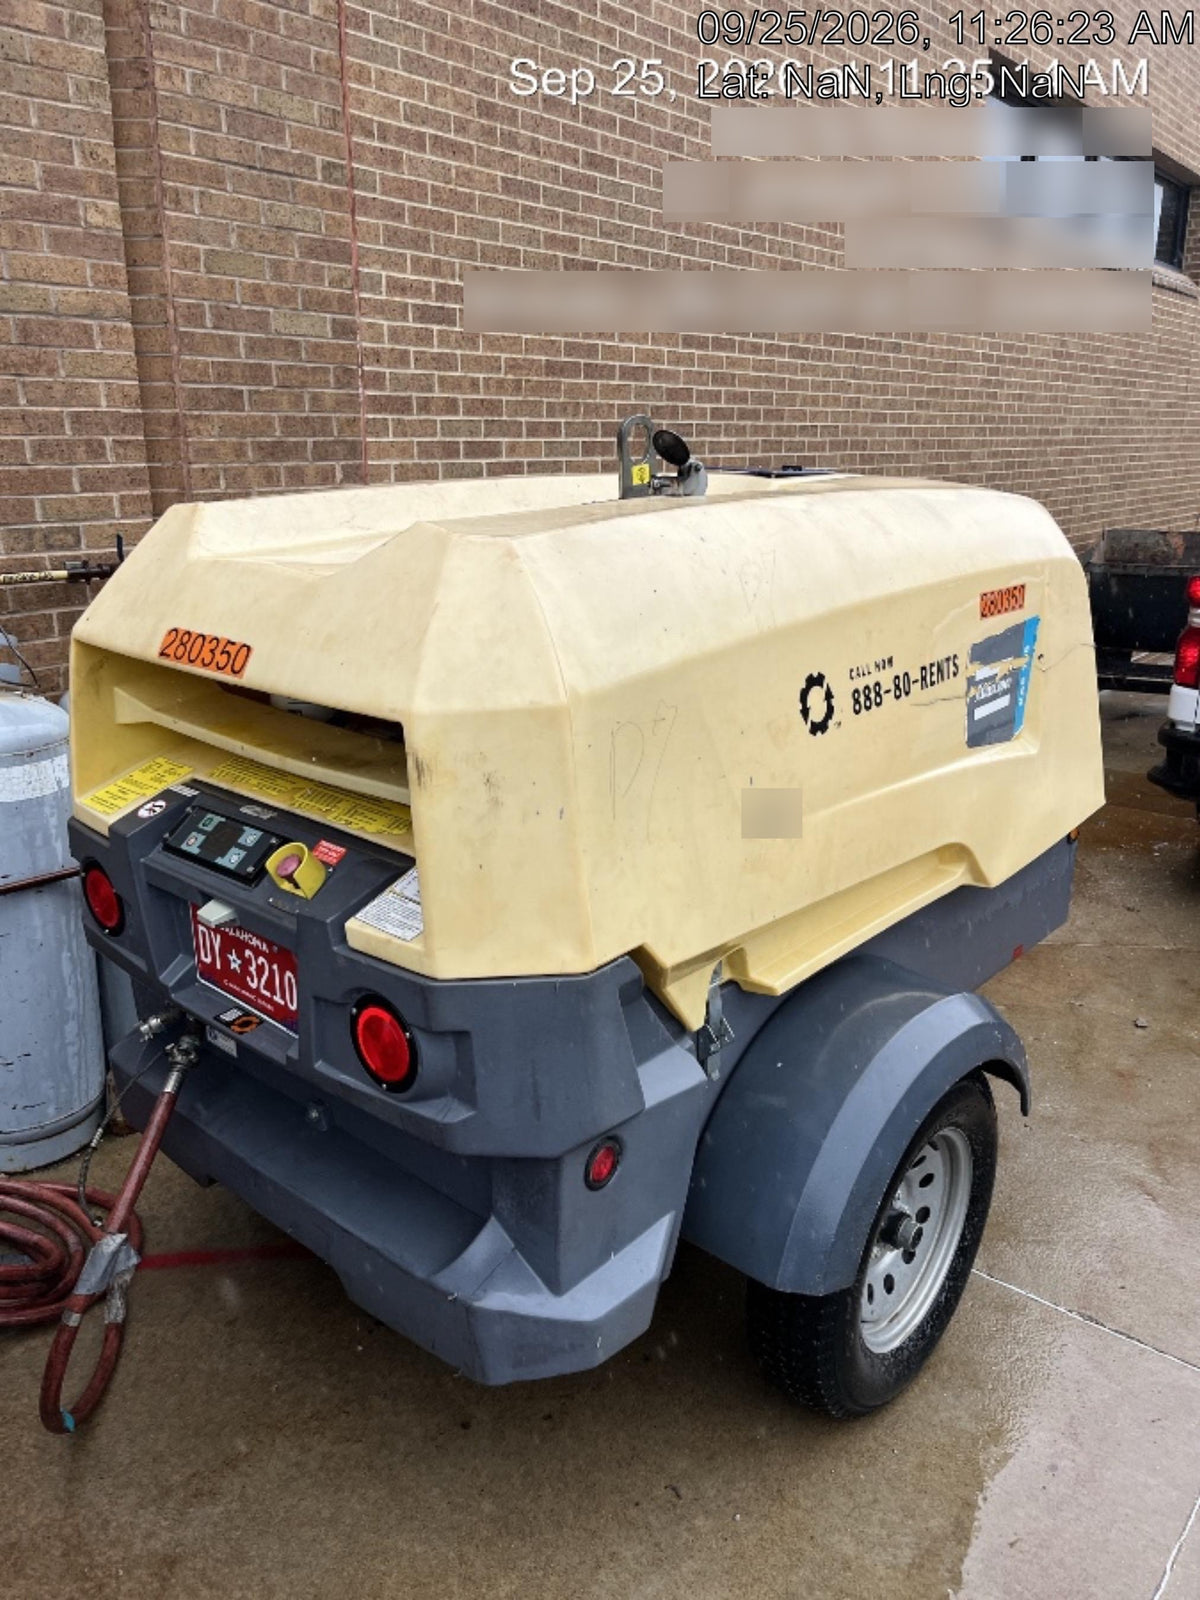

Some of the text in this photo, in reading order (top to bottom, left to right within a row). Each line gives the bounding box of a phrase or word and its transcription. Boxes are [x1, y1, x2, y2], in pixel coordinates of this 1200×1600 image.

[980, 584, 1025, 617] 280350
[160, 627, 252, 675] 280350
[849, 655, 894, 681] CALL NOW
[852, 653, 960, 715] 888-80-RENTS
[198, 923, 222, 970] DY
[244, 948, 298, 1012] 3210
